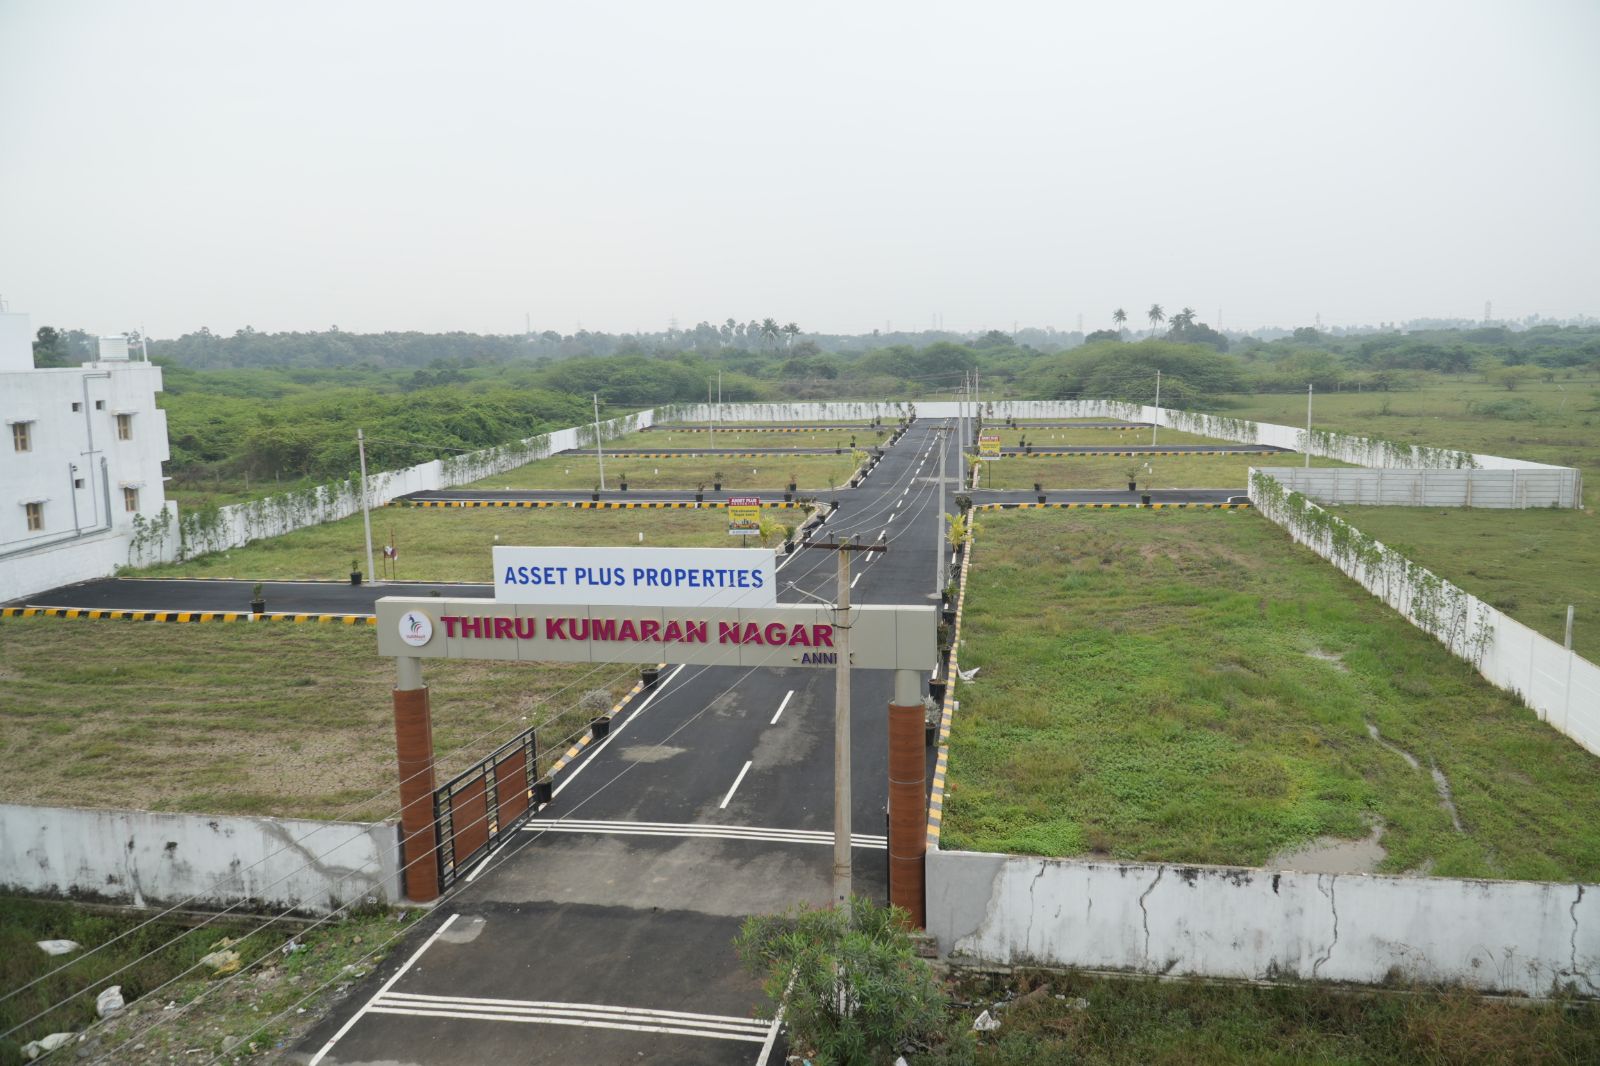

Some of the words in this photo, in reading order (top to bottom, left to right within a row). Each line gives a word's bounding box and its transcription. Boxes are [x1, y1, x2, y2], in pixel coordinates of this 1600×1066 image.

[505, 566, 568, 586] ASSET
[576, 567, 626, 587] PLUS
[633, 567, 763, 589] PROPERTIES
[440, 615, 535, 640] THIRU
[545, 618, 708, 643] KUMARAN
[719, 622, 834, 648] NAGAR
[801, 652, 853, 665] ANN
